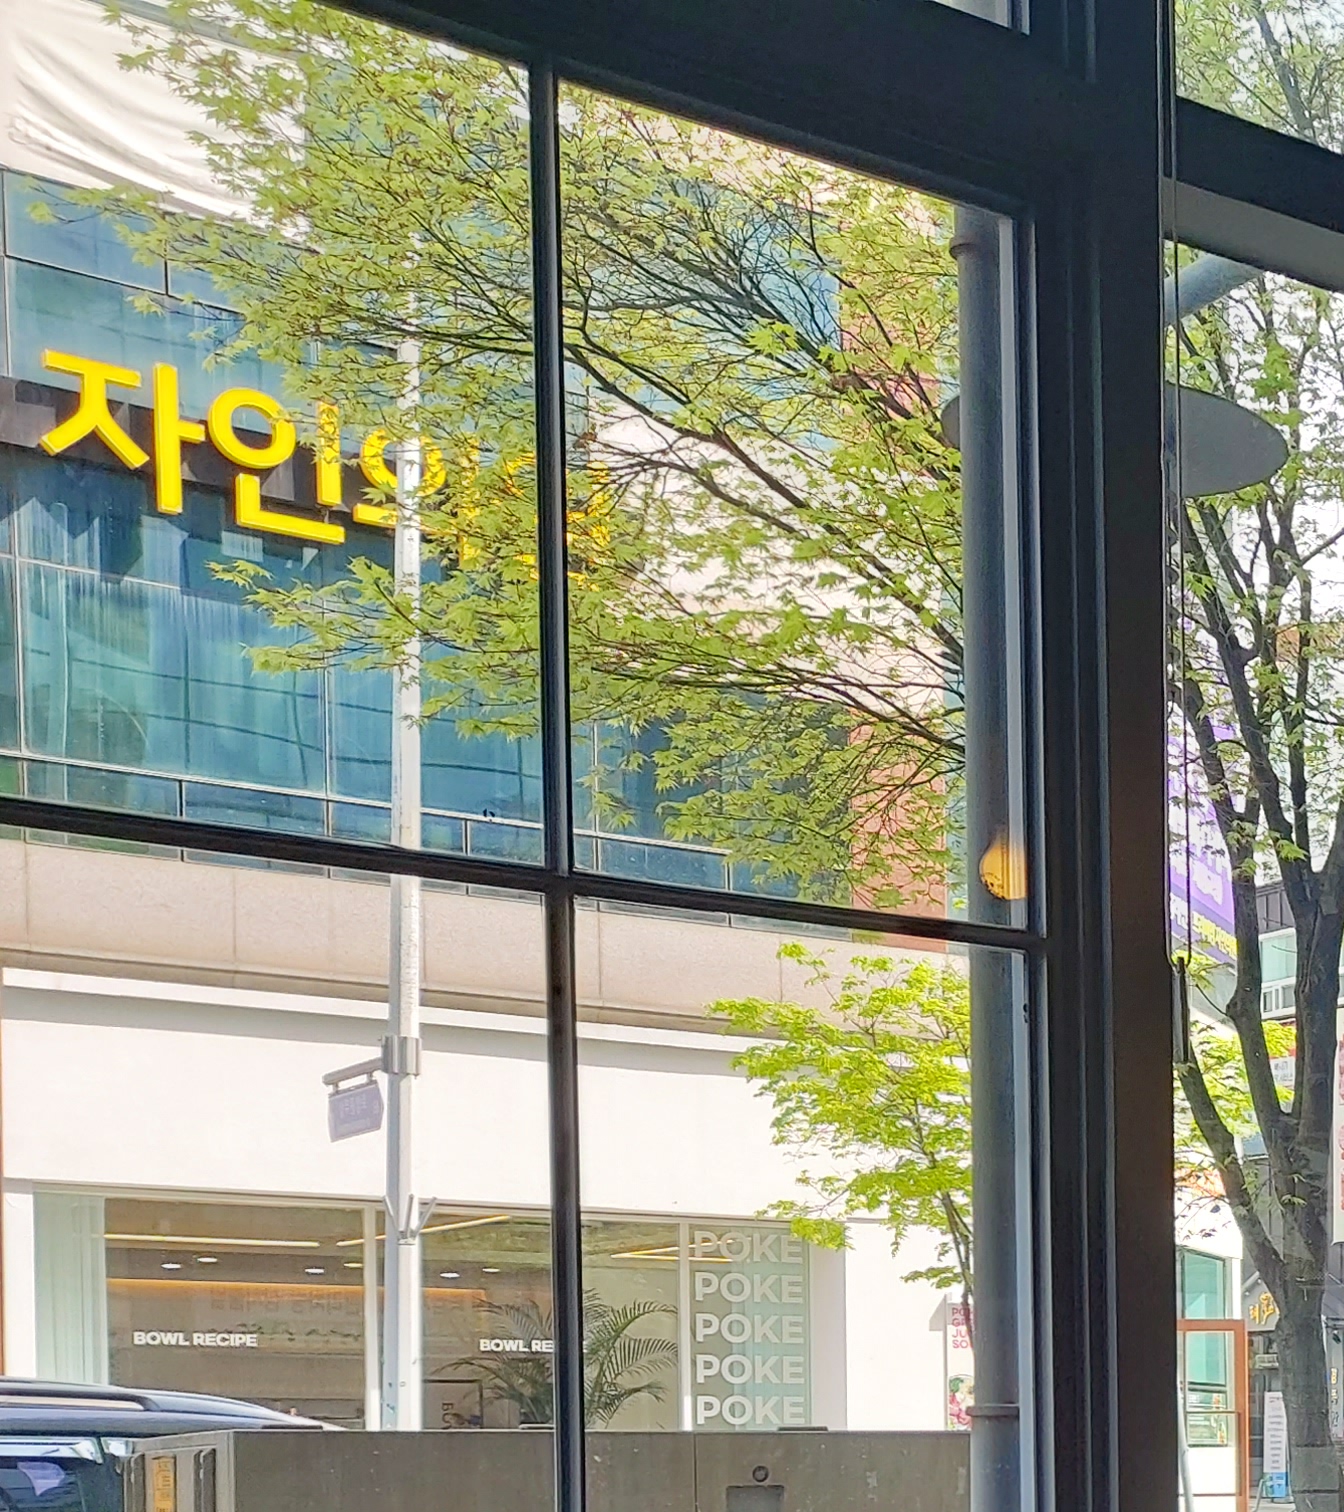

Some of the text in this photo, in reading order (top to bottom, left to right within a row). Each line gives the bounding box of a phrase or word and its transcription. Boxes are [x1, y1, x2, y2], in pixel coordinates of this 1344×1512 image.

[39, 348, 613, 592] 자인의
[694, 1230, 803, 1264] POKE
[694, 1271, 804, 1304] POKE
[133, 1331, 258, 1347] BOWL RECIPE
[695, 1313, 805, 1344] POKE
[479, 1339, 530, 1352] BOWL
[695, 1354, 805, 1385] POKE
[696, 1395, 805, 1425] POKE
